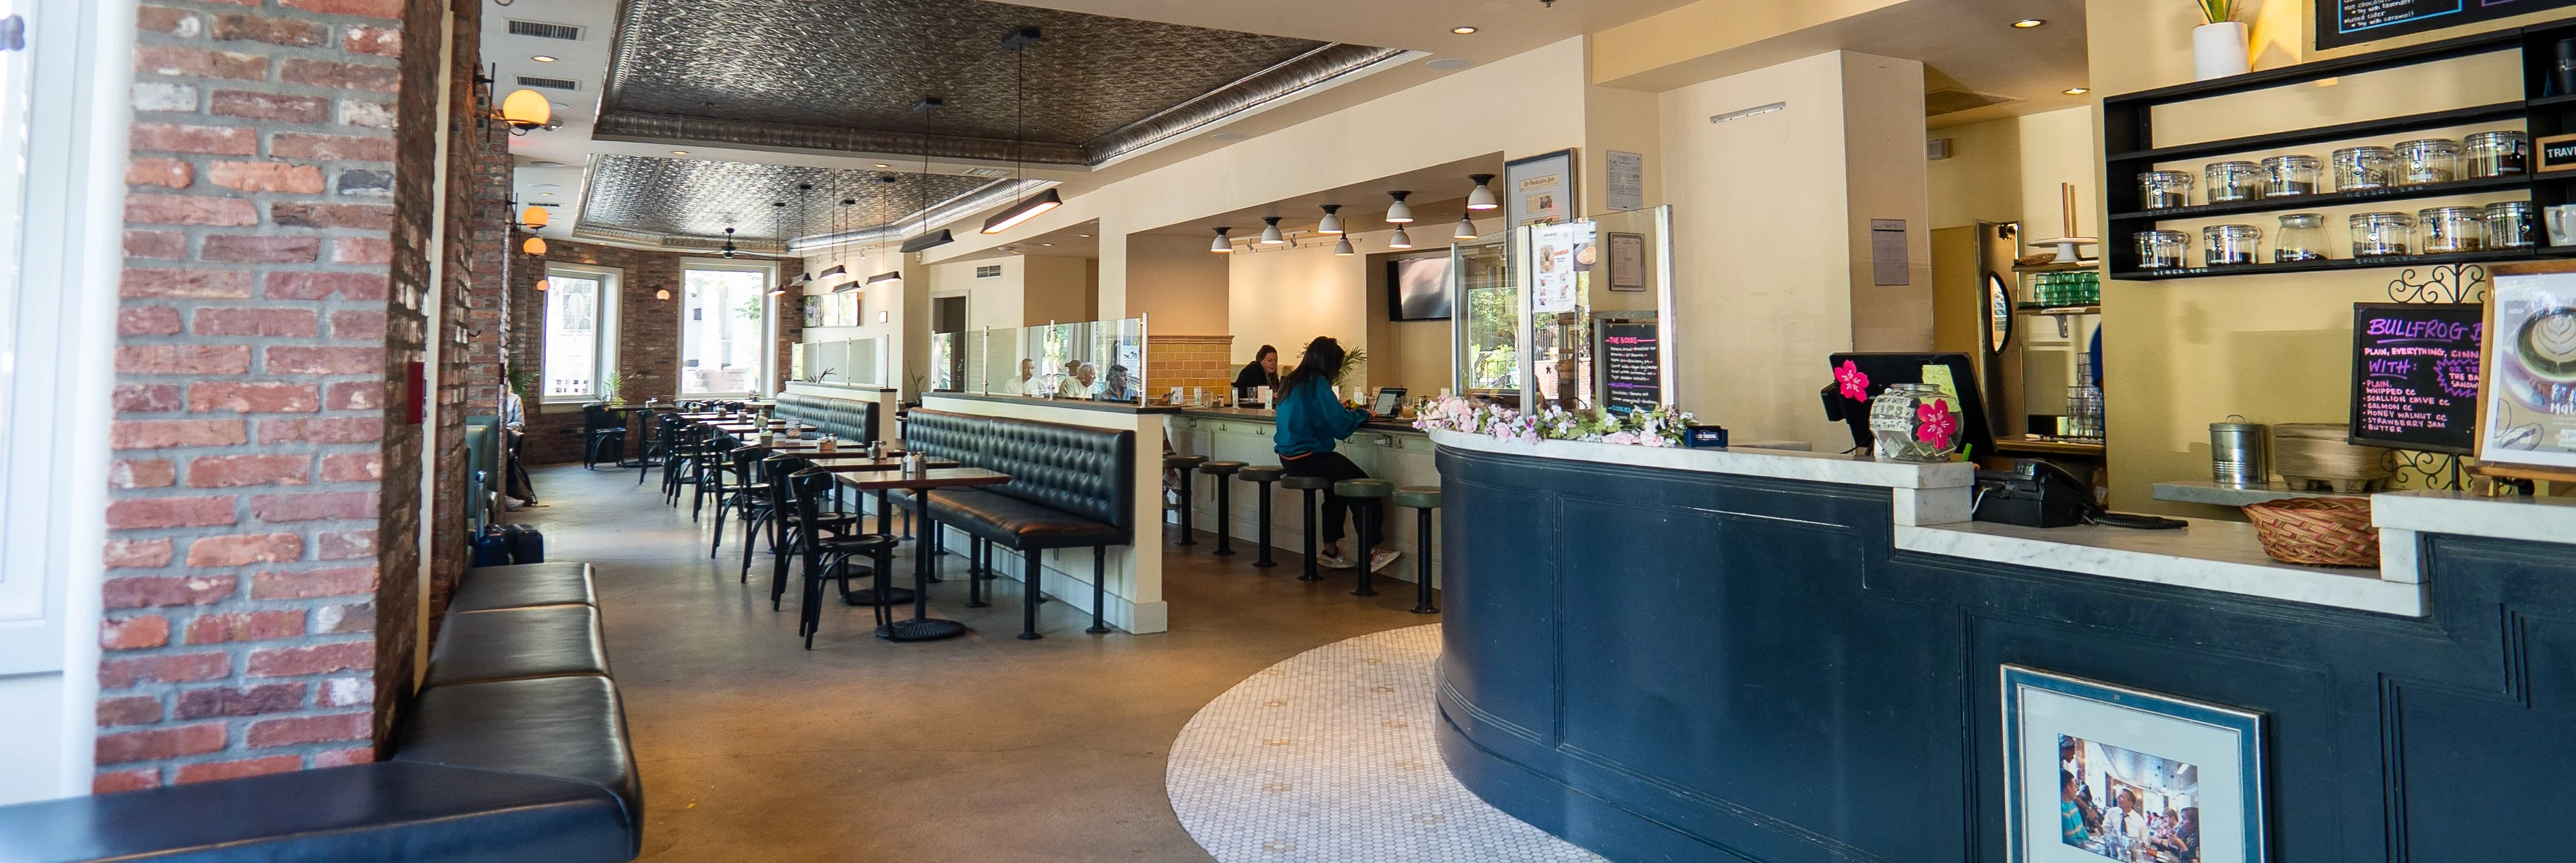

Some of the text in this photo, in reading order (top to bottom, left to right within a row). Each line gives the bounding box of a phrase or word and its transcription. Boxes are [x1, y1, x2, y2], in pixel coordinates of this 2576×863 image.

[2367, 318, 2469, 340] BULLFROG
[2364, 347, 2390, 356] PLAIN,
[2391, 346, 2447, 358] EVERYTHING,
[2551, 402, 2576, 416] Mat
[2367, 417, 2424, 428] STRAWBERRY
[2367, 424, 2402, 433] BUTTER
